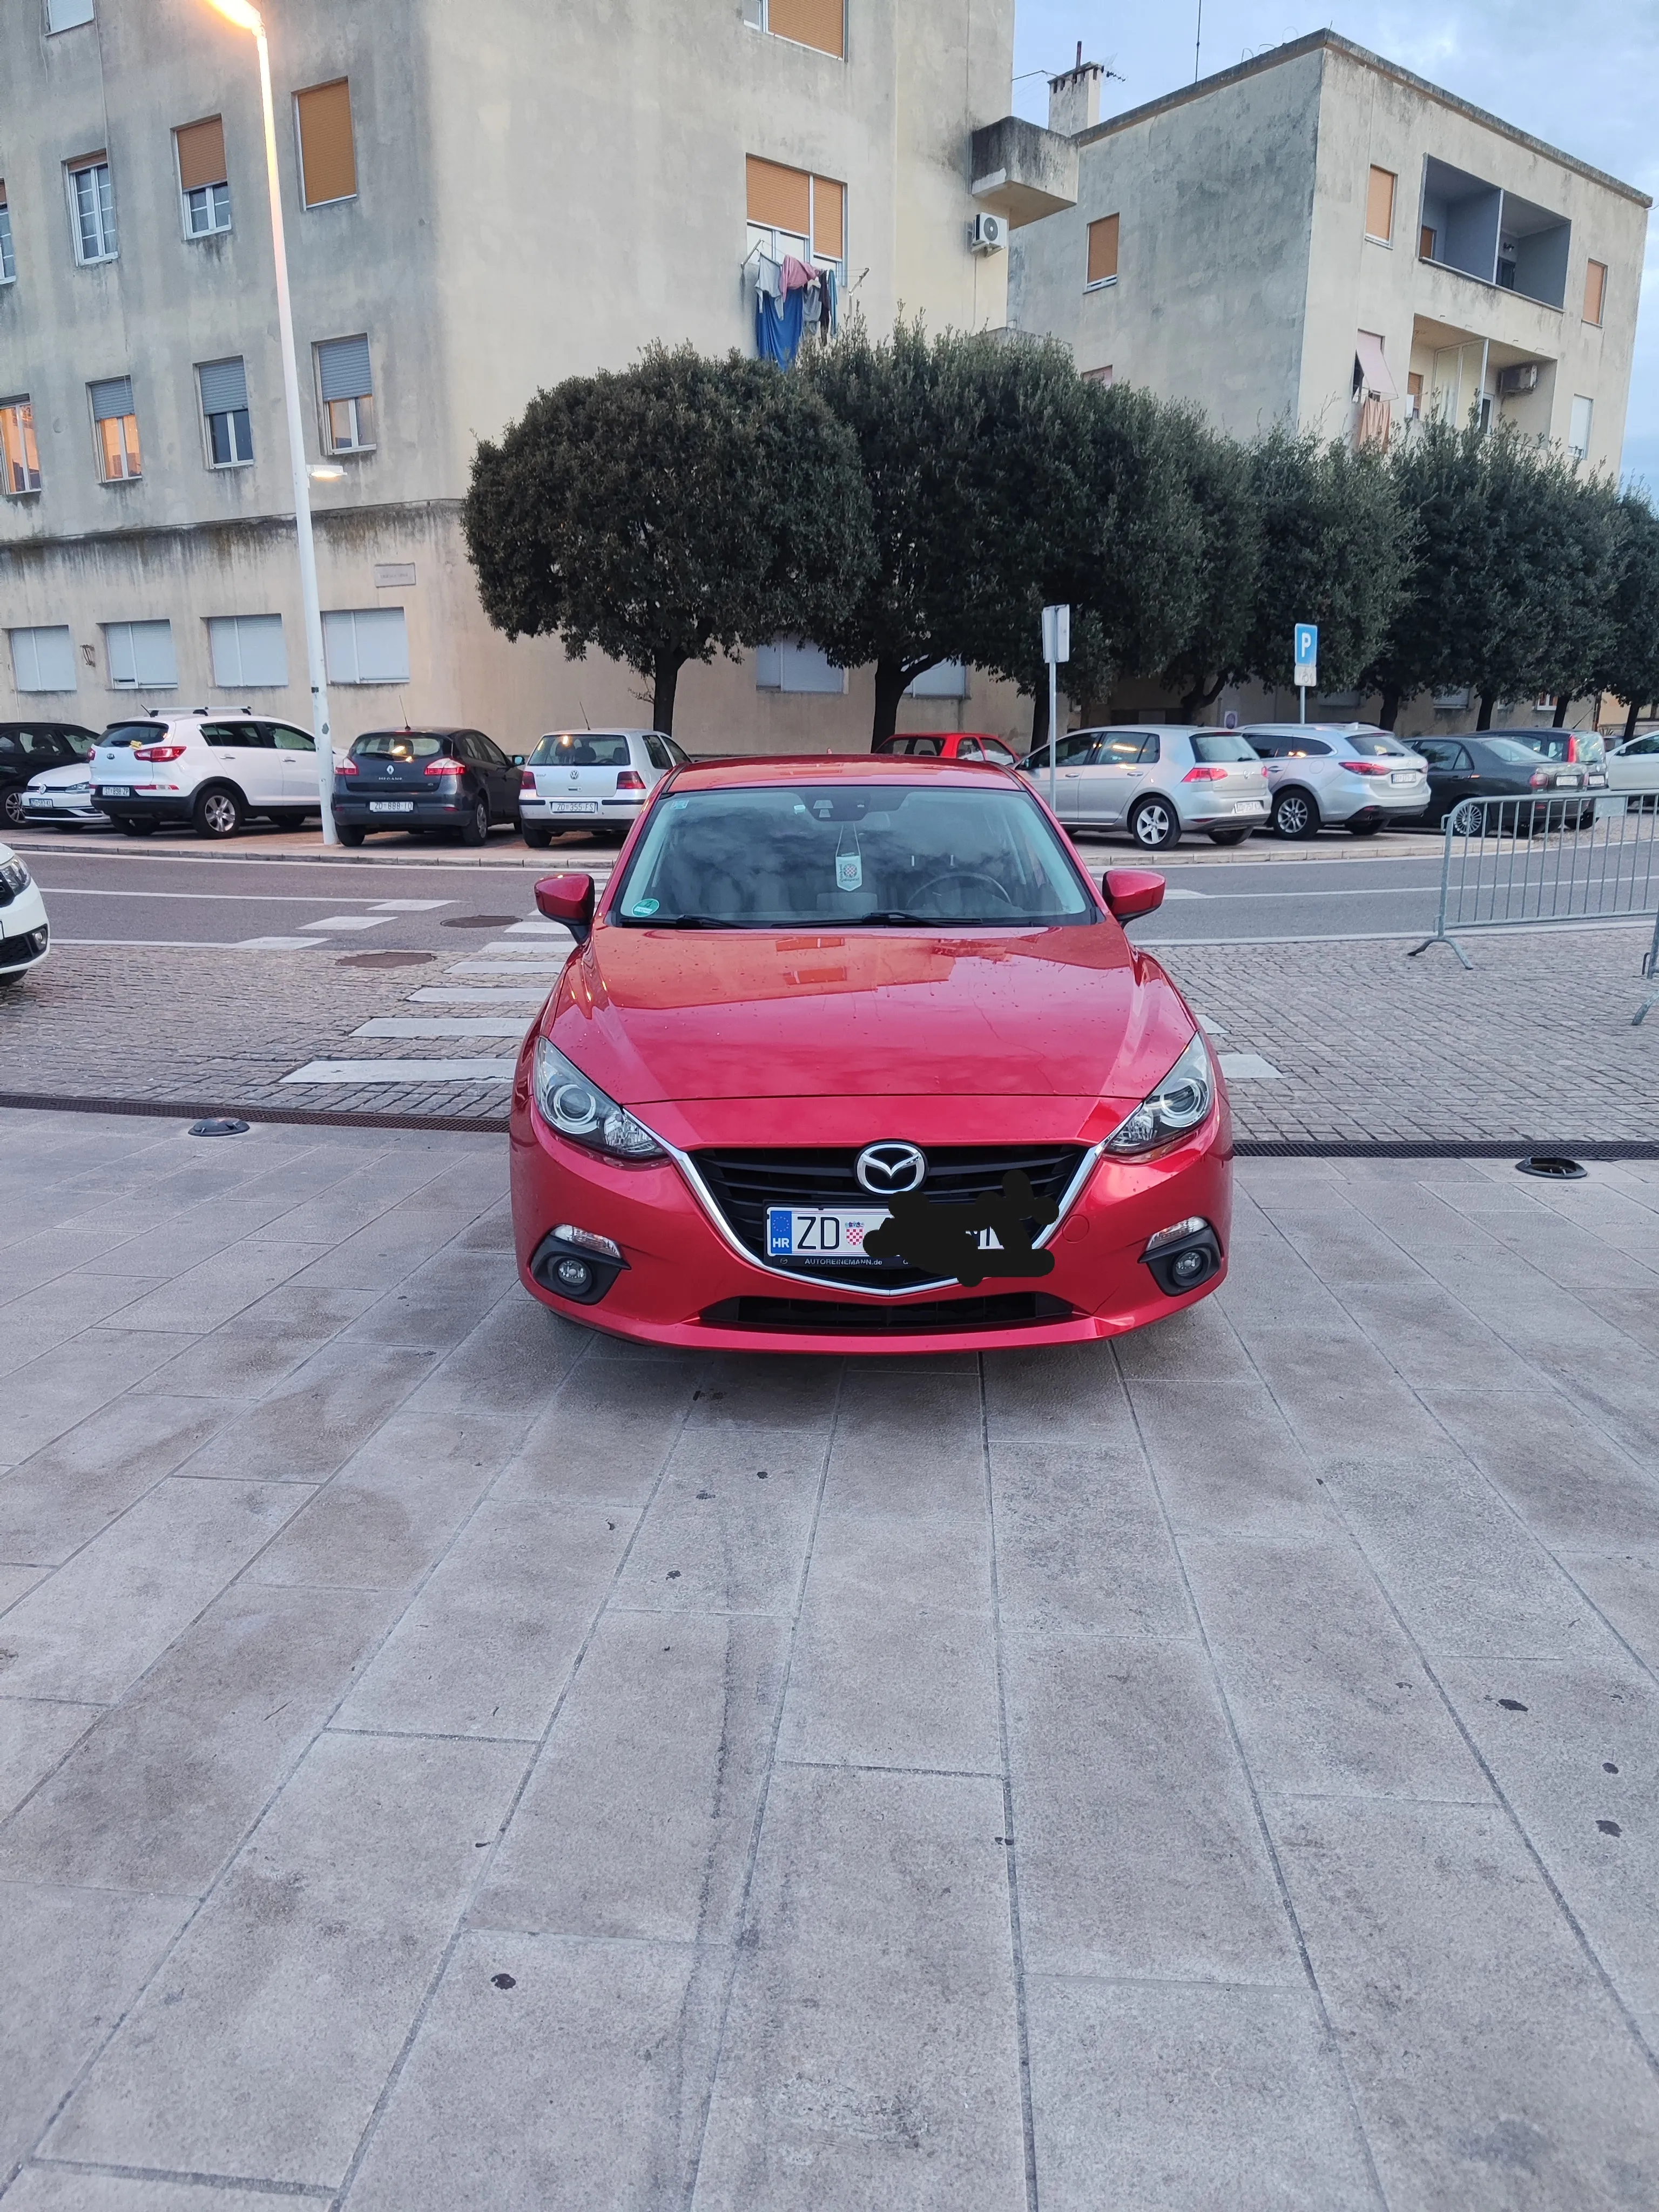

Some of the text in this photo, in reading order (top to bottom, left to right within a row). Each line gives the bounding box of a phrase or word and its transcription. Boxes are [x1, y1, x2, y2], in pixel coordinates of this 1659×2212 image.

[1301, 632, 1312, 658] P
[772, 1237, 791, 1249] HR
[797, 1216, 840, 1250] ZD
